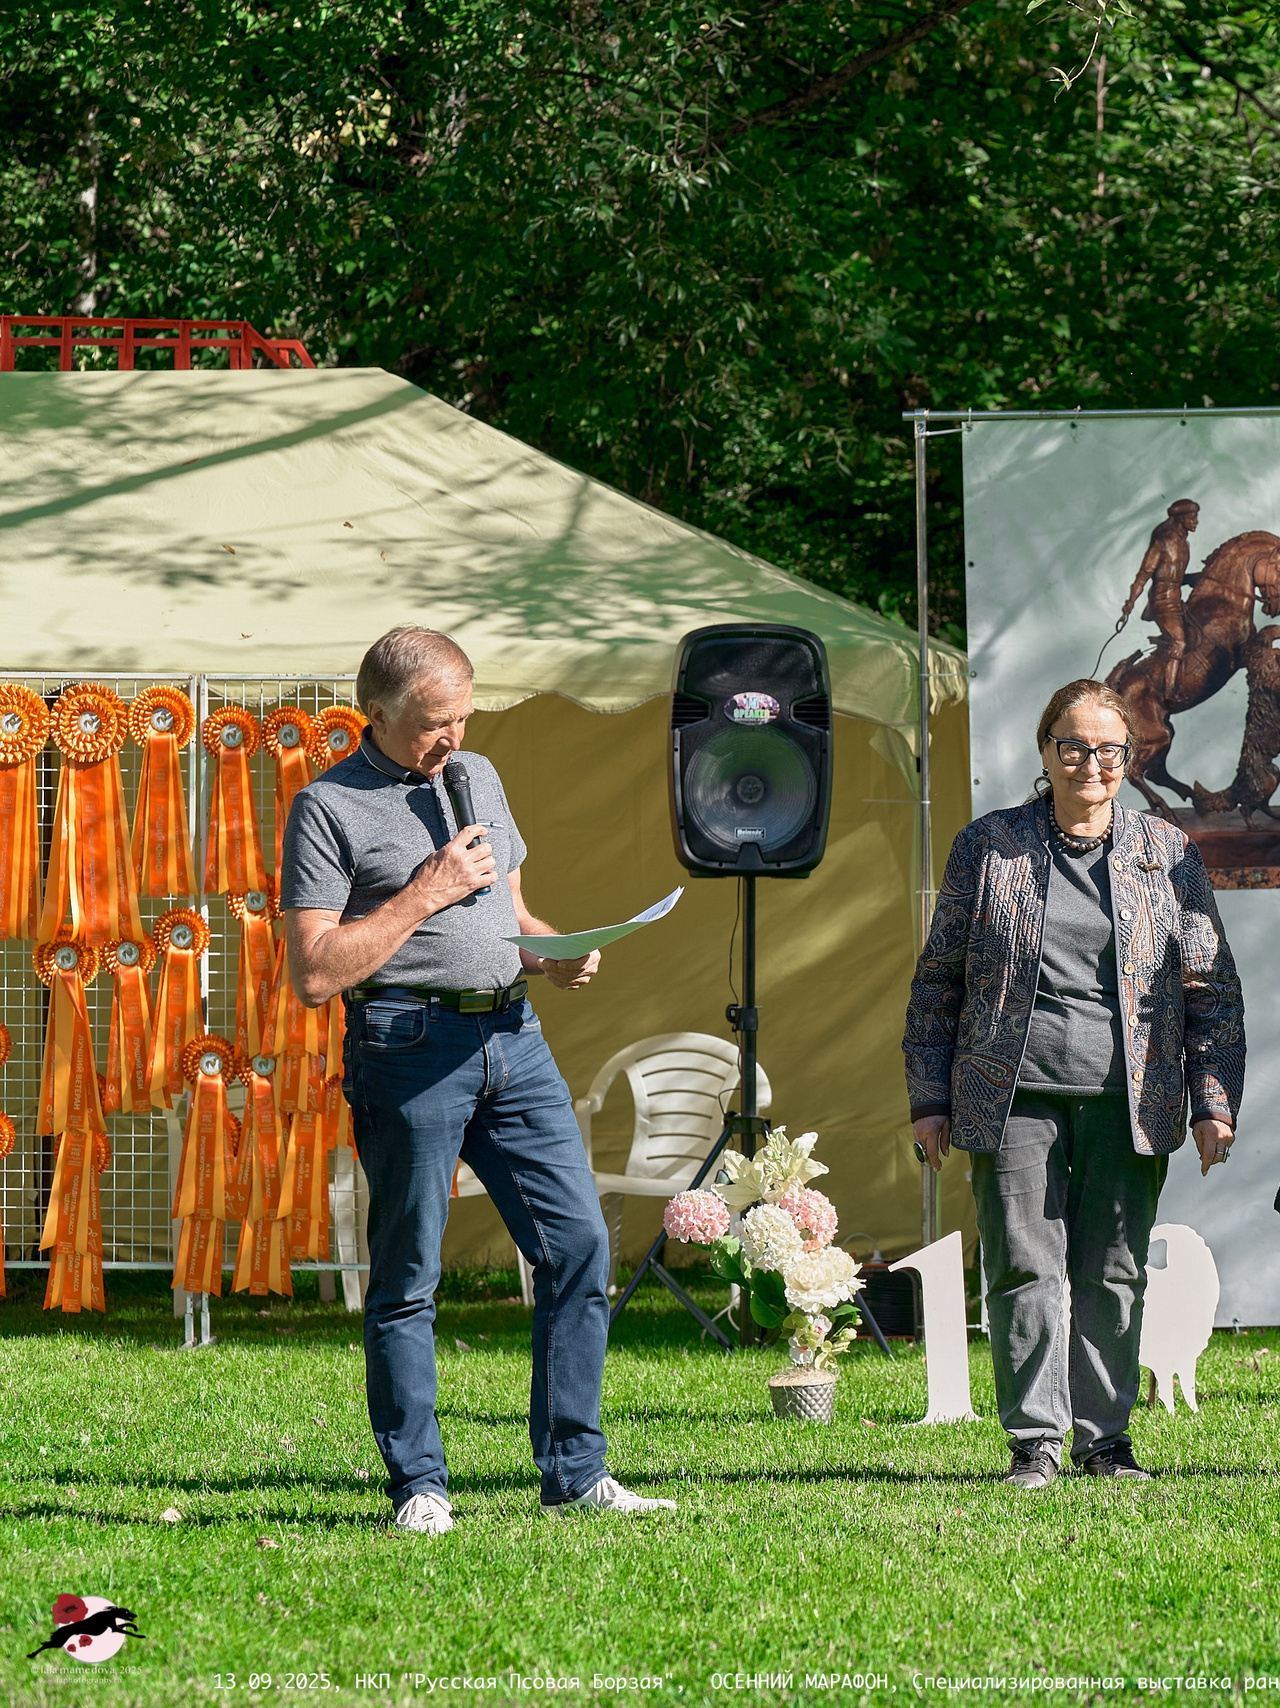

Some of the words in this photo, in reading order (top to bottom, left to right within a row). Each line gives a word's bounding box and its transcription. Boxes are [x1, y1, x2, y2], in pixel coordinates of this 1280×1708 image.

[76, 1034, 84, 1072] ЛУЧШИЙ
[73, 1074, 82, 1110] ВЕТЕРАН
[62, 1193, 71, 1216] ЩЕНКИ
[71, 1175, 80, 1213] ПОБЕДИТЕЛЬ
[68, 1213, 76, 1235] КЛАССА
[887, 1231, 983, 1428] 1
